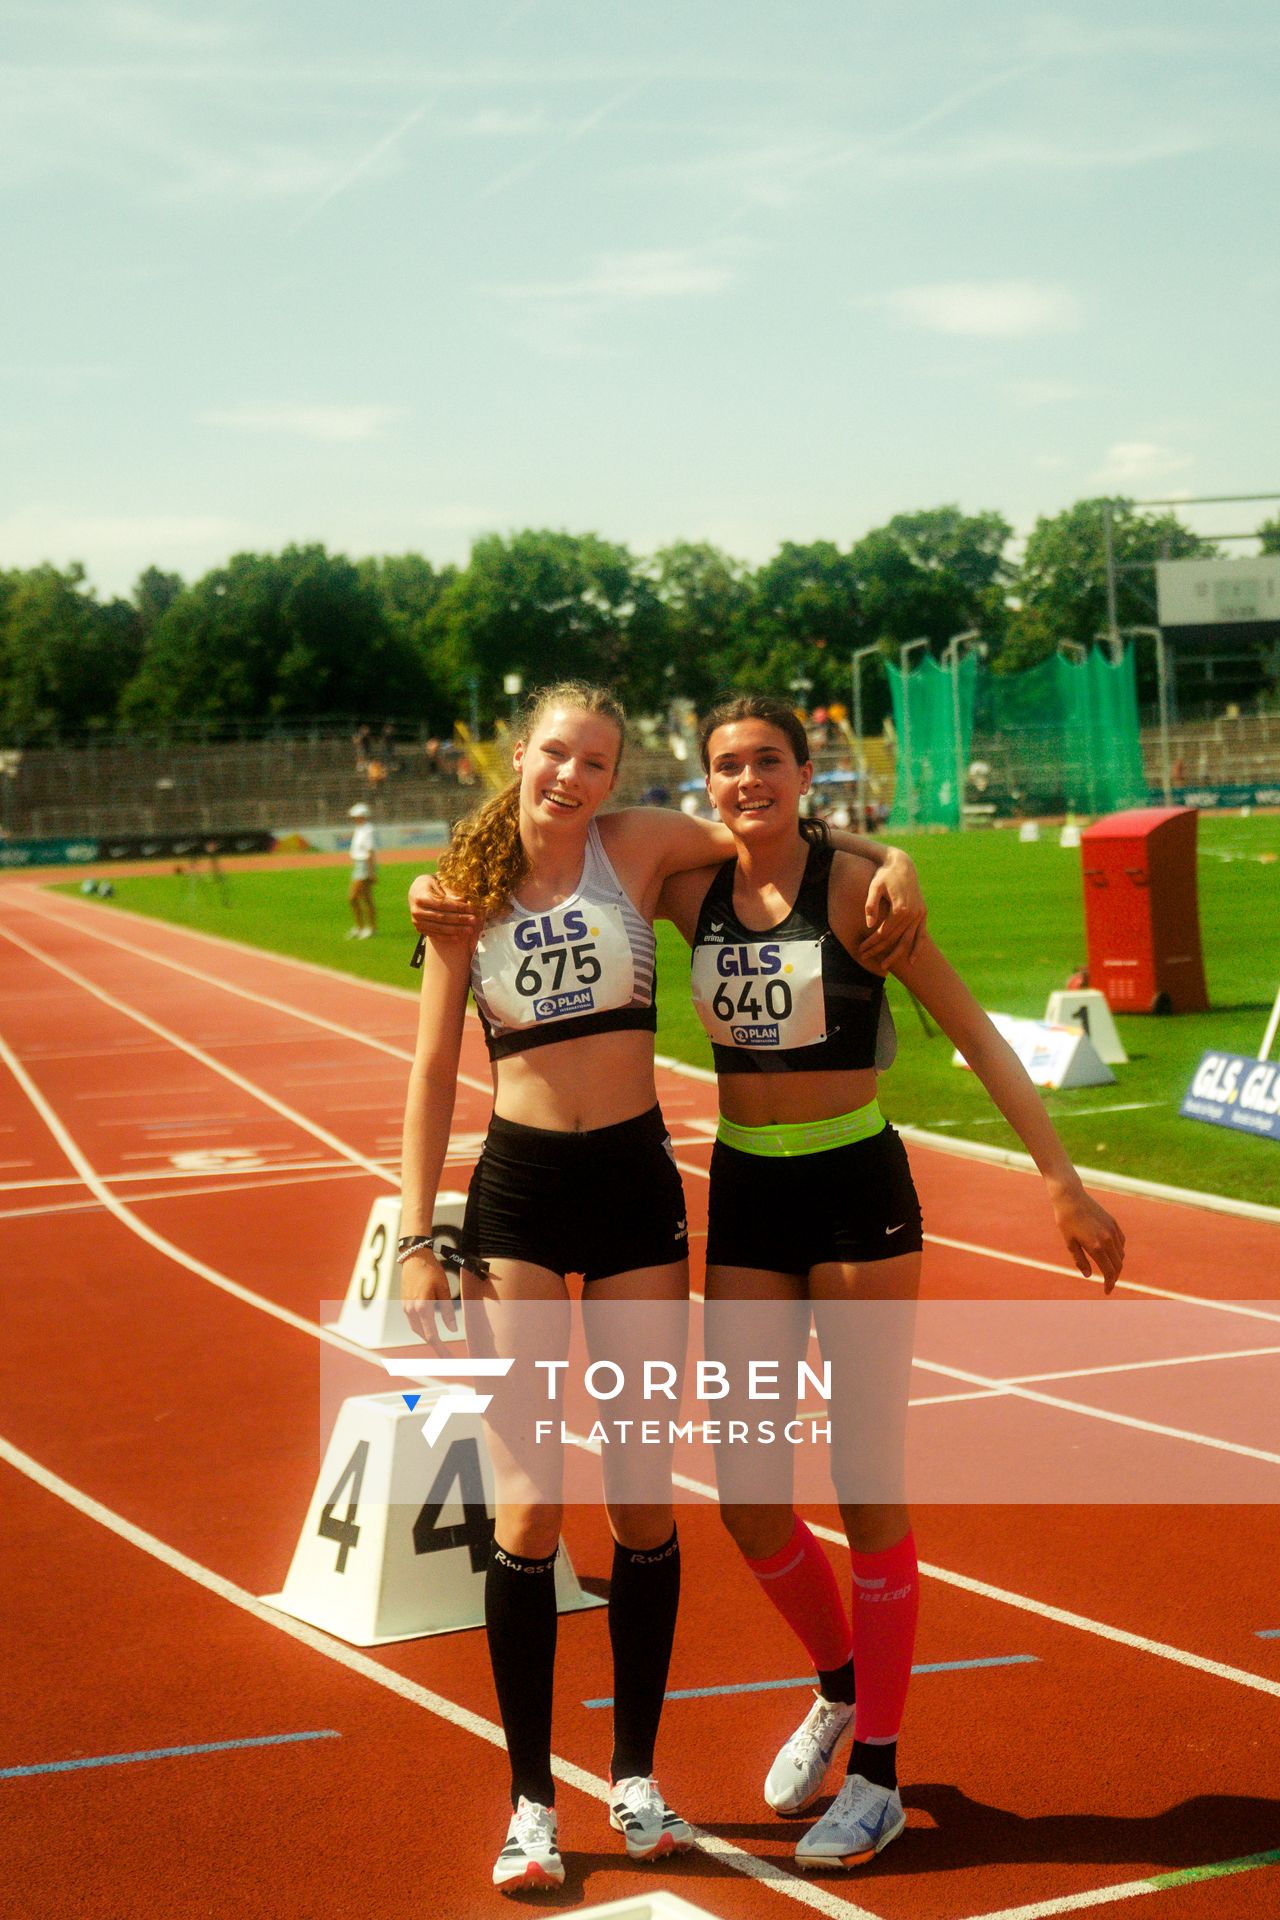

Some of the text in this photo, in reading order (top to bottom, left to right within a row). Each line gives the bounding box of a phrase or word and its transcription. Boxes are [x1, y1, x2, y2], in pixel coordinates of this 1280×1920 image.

[704, 934, 724, 943] erima
[515, 943, 602, 996] 675
[558, 993, 591, 1008] PLAN
[712, 979, 792, 1021] 640
[1072, 1005, 1091, 1037] 1
[749, 1027, 777, 1039] PLAN
[360, 1223, 387, 1310] 3
[317, 1439, 370, 1575] 4
[412, 1437, 497, 1575] 4
